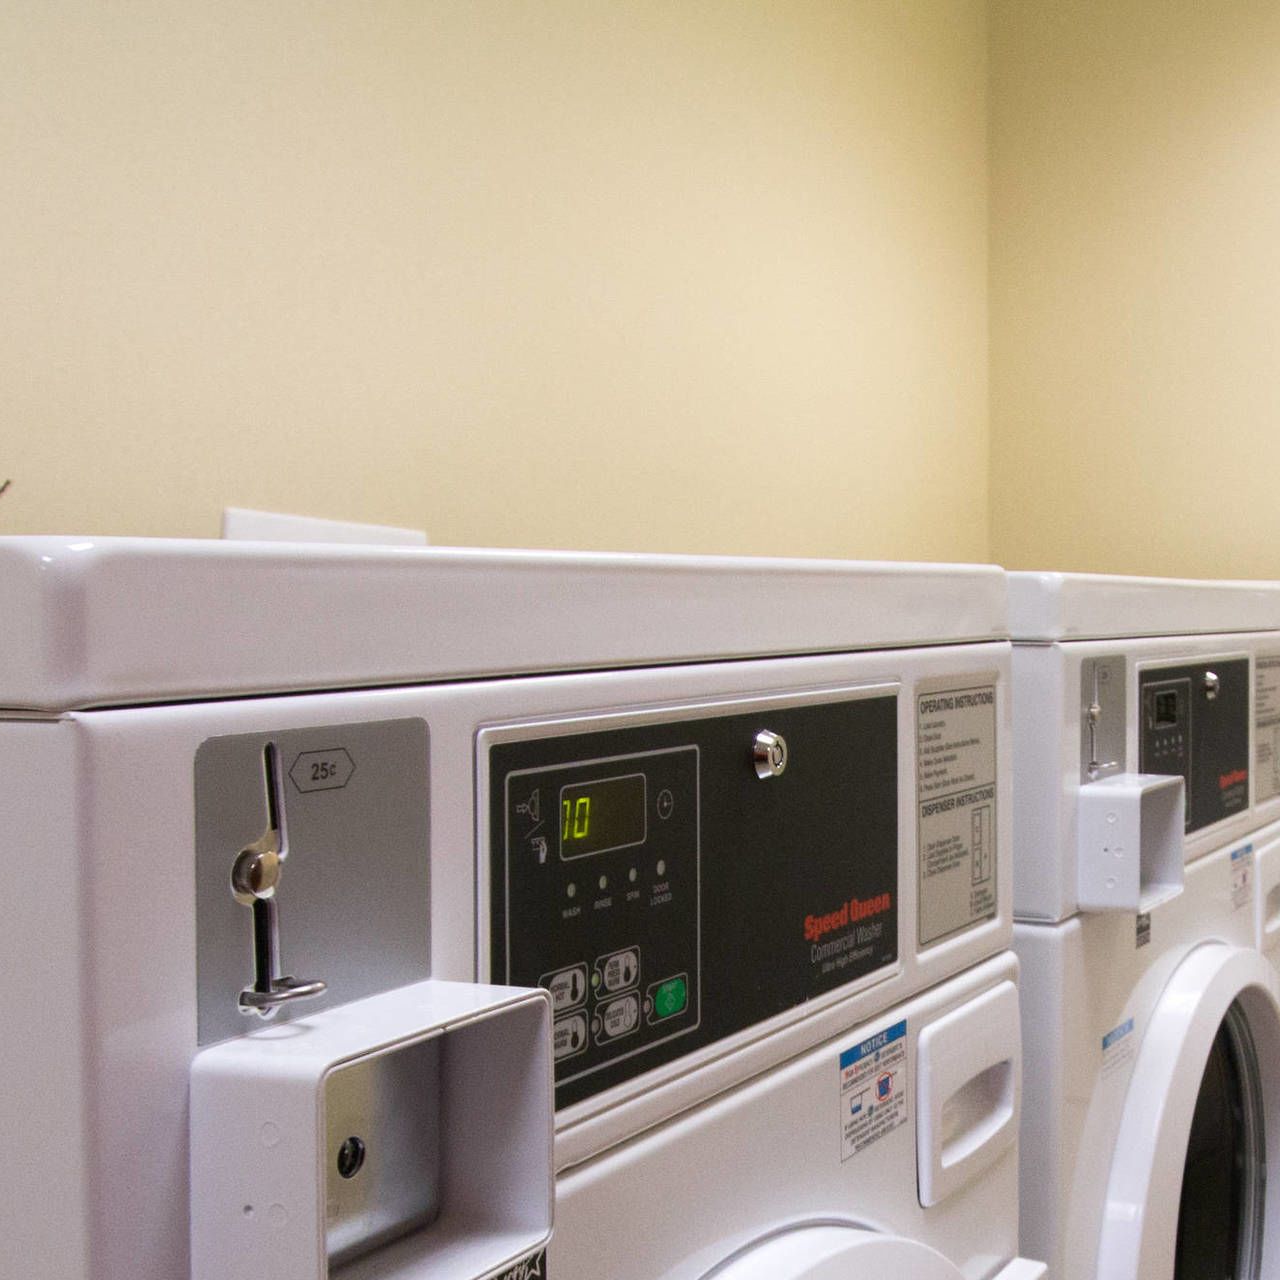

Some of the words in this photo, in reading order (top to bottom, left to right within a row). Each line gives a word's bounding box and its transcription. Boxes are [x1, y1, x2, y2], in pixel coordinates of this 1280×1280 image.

[562, 797, 591, 841] 10
[804, 902, 848, 942] Speed
[850, 893, 890, 922] Queen
[811, 928, 856, 963] Commercial
[860, 1032, 888, 1056] NOTICE
